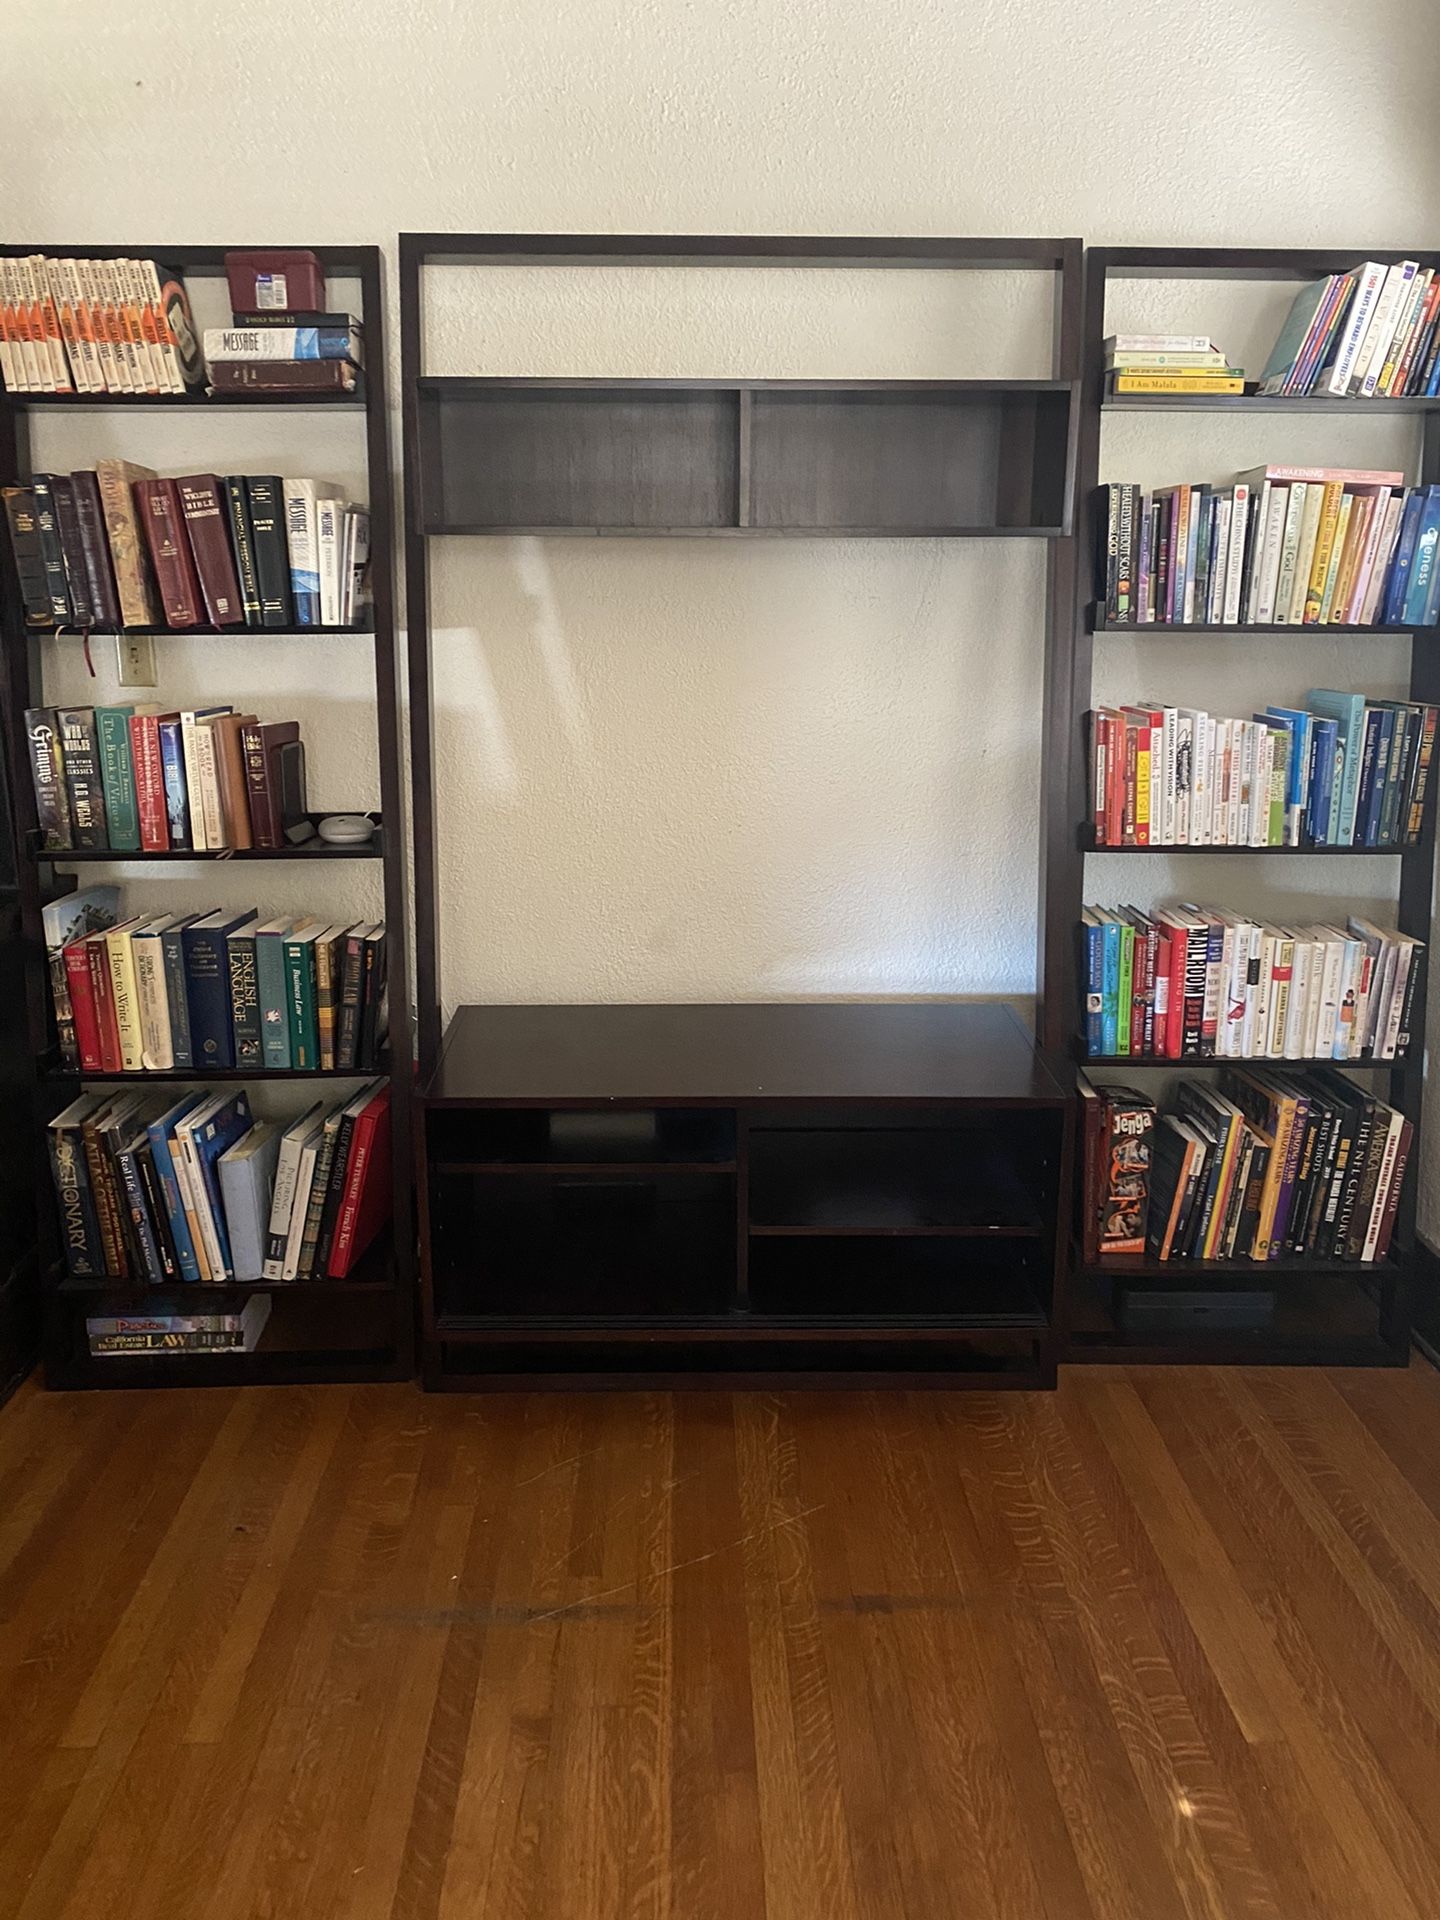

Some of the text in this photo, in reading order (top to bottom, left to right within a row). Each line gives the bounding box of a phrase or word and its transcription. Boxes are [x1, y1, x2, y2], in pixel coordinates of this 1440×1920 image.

[43, 306, 56, 337] ROMANS
[156, 317, 171, 355] REVELATION
[1339, 275, 1378, 377] 1501 WAYS TO REWARD EMPLOYEES
[222, 332, 260, 351] MESSAGE
[1152, 378, 1177, 389] Malala
[186, 499, 216, 511] BIBLE
[233, 501, 246, 540] FINANCIAL
[289, 498, 308, 534] MESSAGE
[319, 511, 334, 537] MESSAGE
[1119, 486, 1131, 580] HEALED WITHOUT SCARS
[1232, 502, 1245, 573] THE CHINA STUDY
[1269, 498, 1281, 549] AWAKEN
[1109, 535, 1119, 556] GOD
[1282, 551, 1294, 571] God
[1215, 558, 1226, 600] IMMUNITY
[103, 719, 115, 741] The
[1354, 710, 1362, 722] The
[133, 726, 142, 747] WITH
[1198, 716, 1206, 759] STEALING
[1351, 723, 1362, 747] Power
[29, 724, 58, 785] Grimm's
[106, 744, 118, 772] Book
[148, 726, 161, 796] THE NEW OXFORD
[1167, 749, 1175, 771] WITH
[1392, 747, 1402, 764] YOUR
[137, 763, 147, 804] APOCRYPHA
[167, 765, 178, 785] BIBLE
[1345, 757, 1359, 796] Metaphor
[1389, 764, 1399, 782] CHILD
[73, 783, 94, 829] H.G. WELLS
[110, 787, 122, 828] Virtues
[112, 953, 124, 977] How
[138, 955, 149, 987] DICTIONARY
[1094, 940, 1102, 989] GOOD SON
[1145, 930, 1156, 987] PRESIDENT WAS SHOT
[1176, 944, 1185, 996] CHECKING
[1185, 928, 1209, 995] MAILROOM
[1314, 952, 1324, 978] blink
[115, 980, 123, 992] to
[229, 953, 247, 1023] LANGUAGE
[242, 953, 258, 1007] ENGLISH
[292, 968, 304, 1016] Business Law
[117, 993, 130, 1020] Write
[1144, 1006, 1153, 1041] BILL O'REILLY
[1276, 985, 1288, 1046] ARIANNA HUFFINGTON
[1113, 1112, 1152, 1135] Jenga
[1304, 1126, 1318, 1157] Journey
[331, 1121, 353, 1191] KELLY WEARSTLER
[1279, 1128, 1290, 1160] AMAZING
[1291, 1128, 1304, 1159] AMAZING
[1312, 1121, 1330, 1173] BEST SHOTS
[1366, 1120, 1389, 1172] AMERICA
[119, 1155, 131, 1175] Real
[1274, 1160, 1285, 1185] YEARS
[1287, 1160, 1298, 1184] YEARS
[1335, 1120, 1372, 1240] THE NFL CENTURY
[56, 1142, 88, 1252] DICTIONARY
[124, 1175, 136, 1192] Life
[272, 1179, 286, 1215] ANGELES
[281, 1167, 296, 1210] PICTURING
[338, 1146, 366, 1249] PETER TURNLEY French Kiss
[1367, 1134, 1398, 1244] TROJAN FOOTBALL MEDIA GUIDE
[1387, 1155, 1406, 1213] CALIFORNIA
[88, 1143, 104, 1185] ATLAS
[103, 1234, 119, 1271] BIBLE
[1204, 1194, 1214, 1211] Legal
[1200, 1211, 1211, 1237] Updates
[104, 1333, 189, 1348] California LAW
